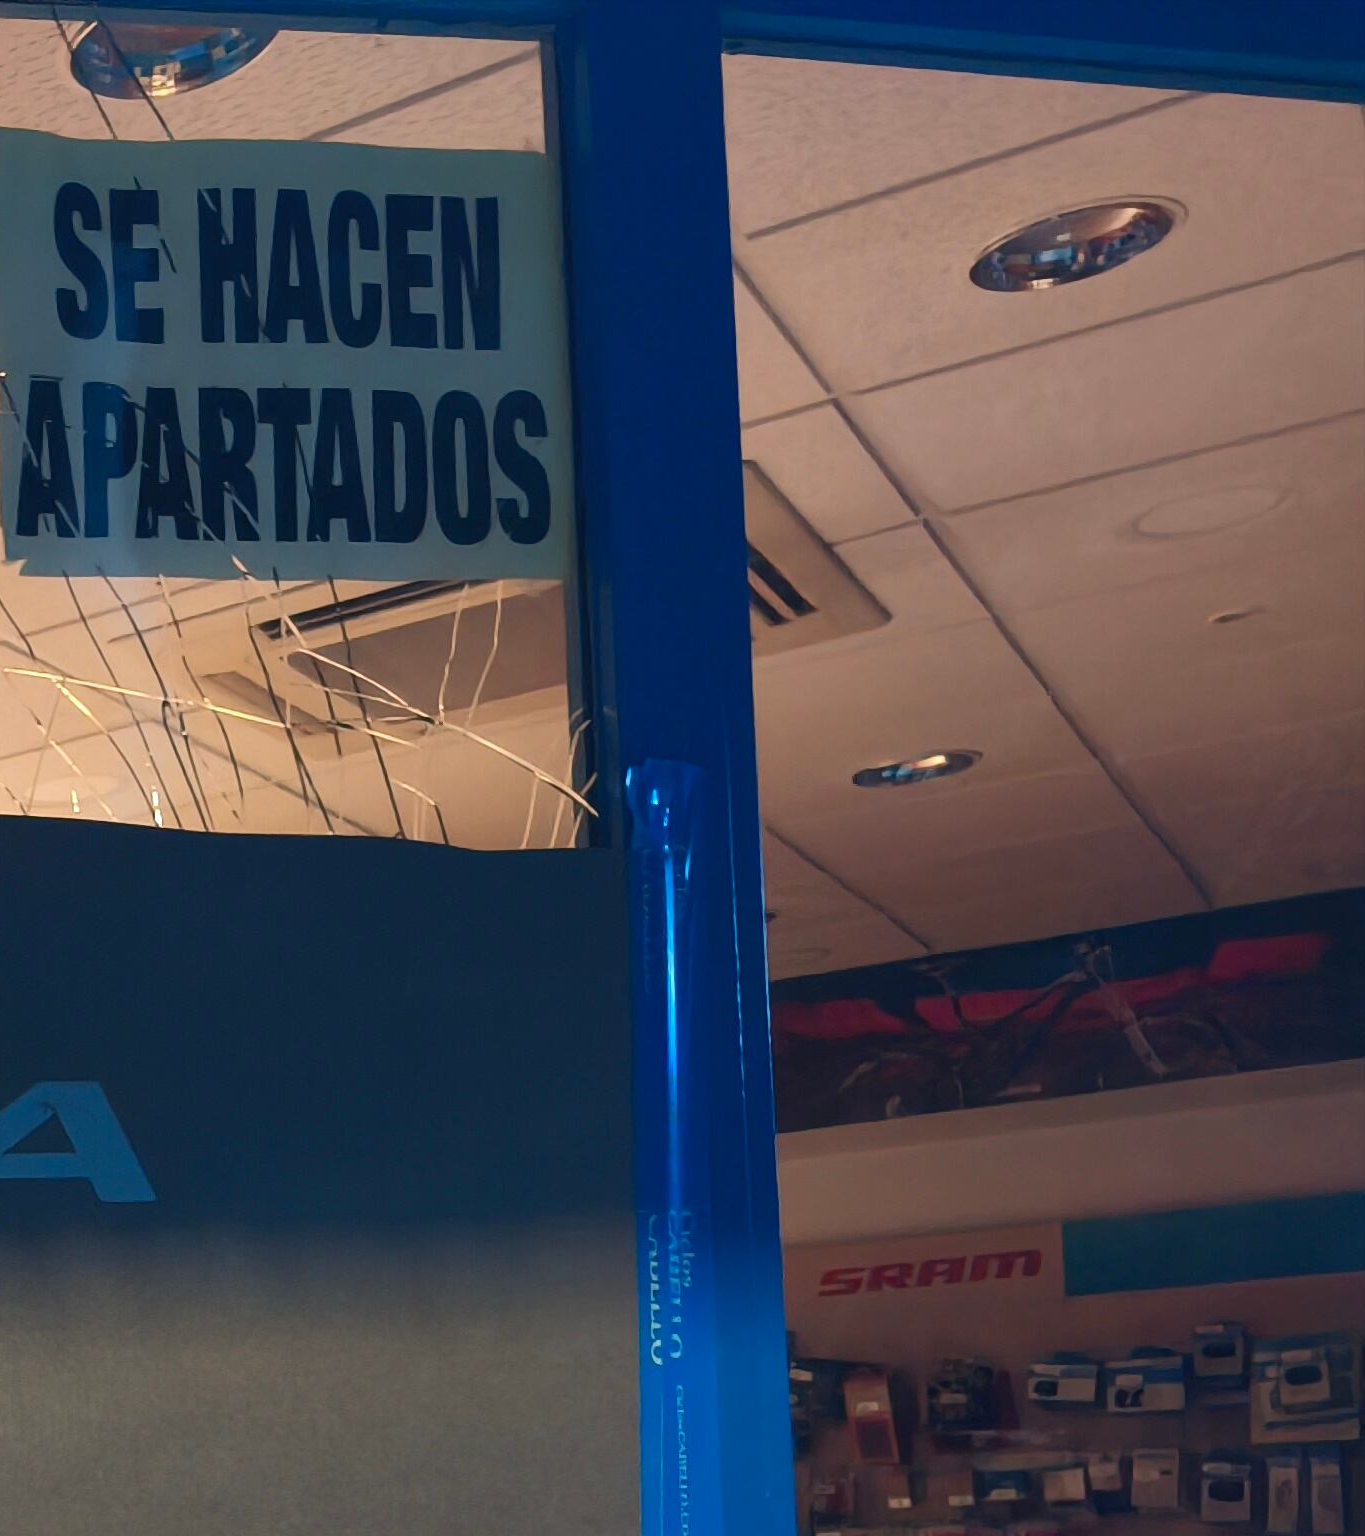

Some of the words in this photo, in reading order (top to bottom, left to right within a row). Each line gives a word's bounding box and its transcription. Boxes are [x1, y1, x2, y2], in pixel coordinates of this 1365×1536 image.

[53, 182, 165, 345] SE
[197, 187, 501, 351] HACEN
[14, 376, 551, 545] APARTADOS
[817, 1250, 1042, 1297] SRAM
